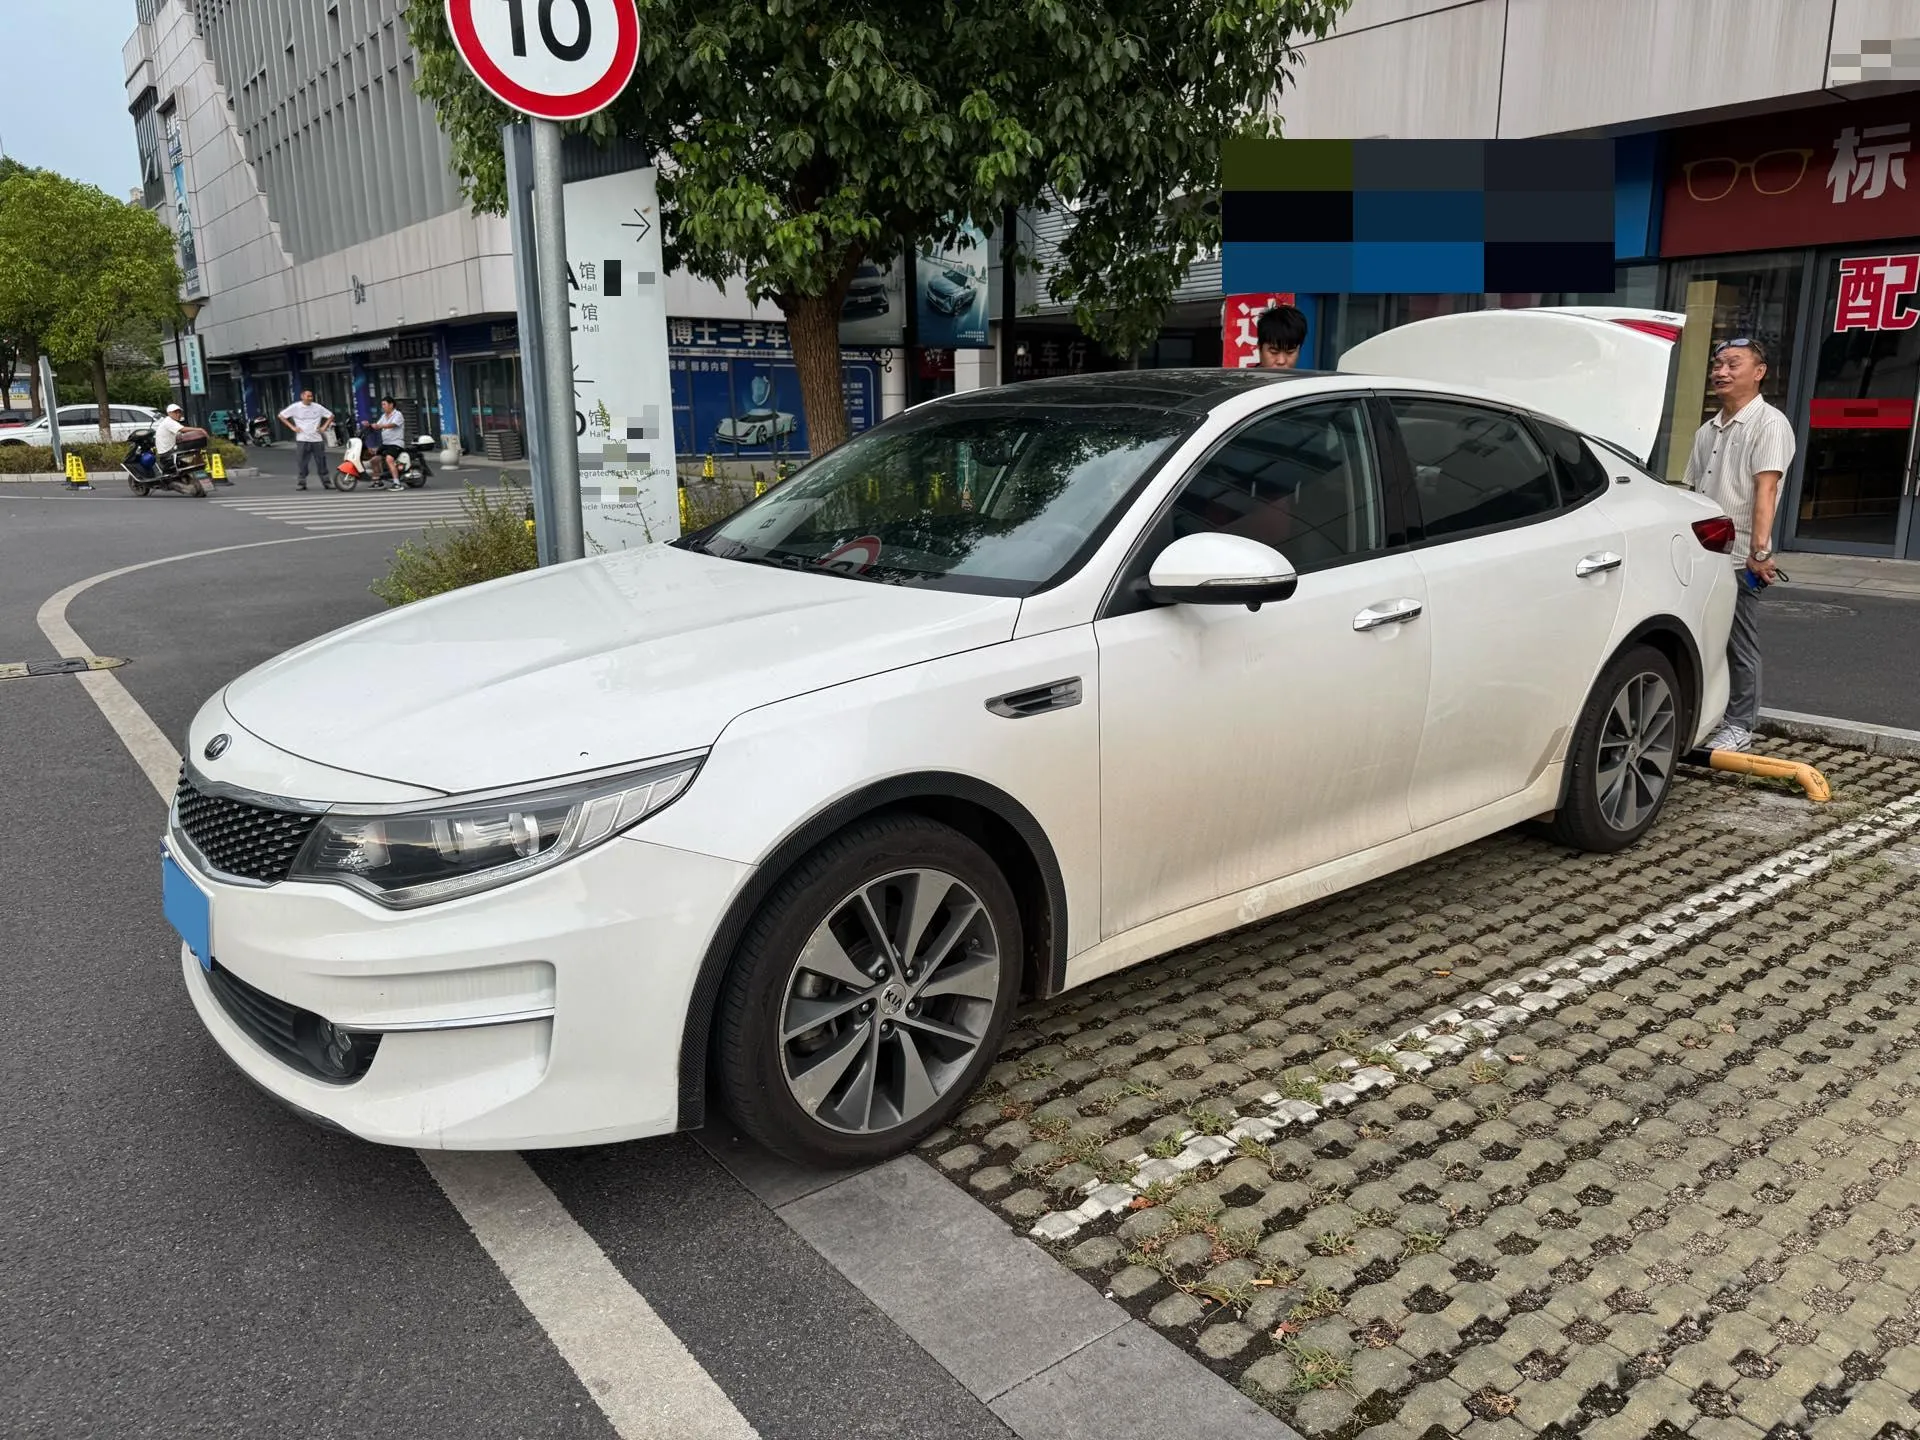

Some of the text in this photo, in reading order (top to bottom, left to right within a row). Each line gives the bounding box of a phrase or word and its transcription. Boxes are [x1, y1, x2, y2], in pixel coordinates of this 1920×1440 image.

[500, 0, 592, 62] 10
[1825, 122, 1911, 204] 标
[580, 283, 598, 292] Hall
[1834, 254, 1920, 333] 配
[582, 325, 600, 333] Hall
[669, 319, 791, 348] 博士二手车
[580, 470, 609, 479] egrated
[884, 990, 902, 1008] KIA
